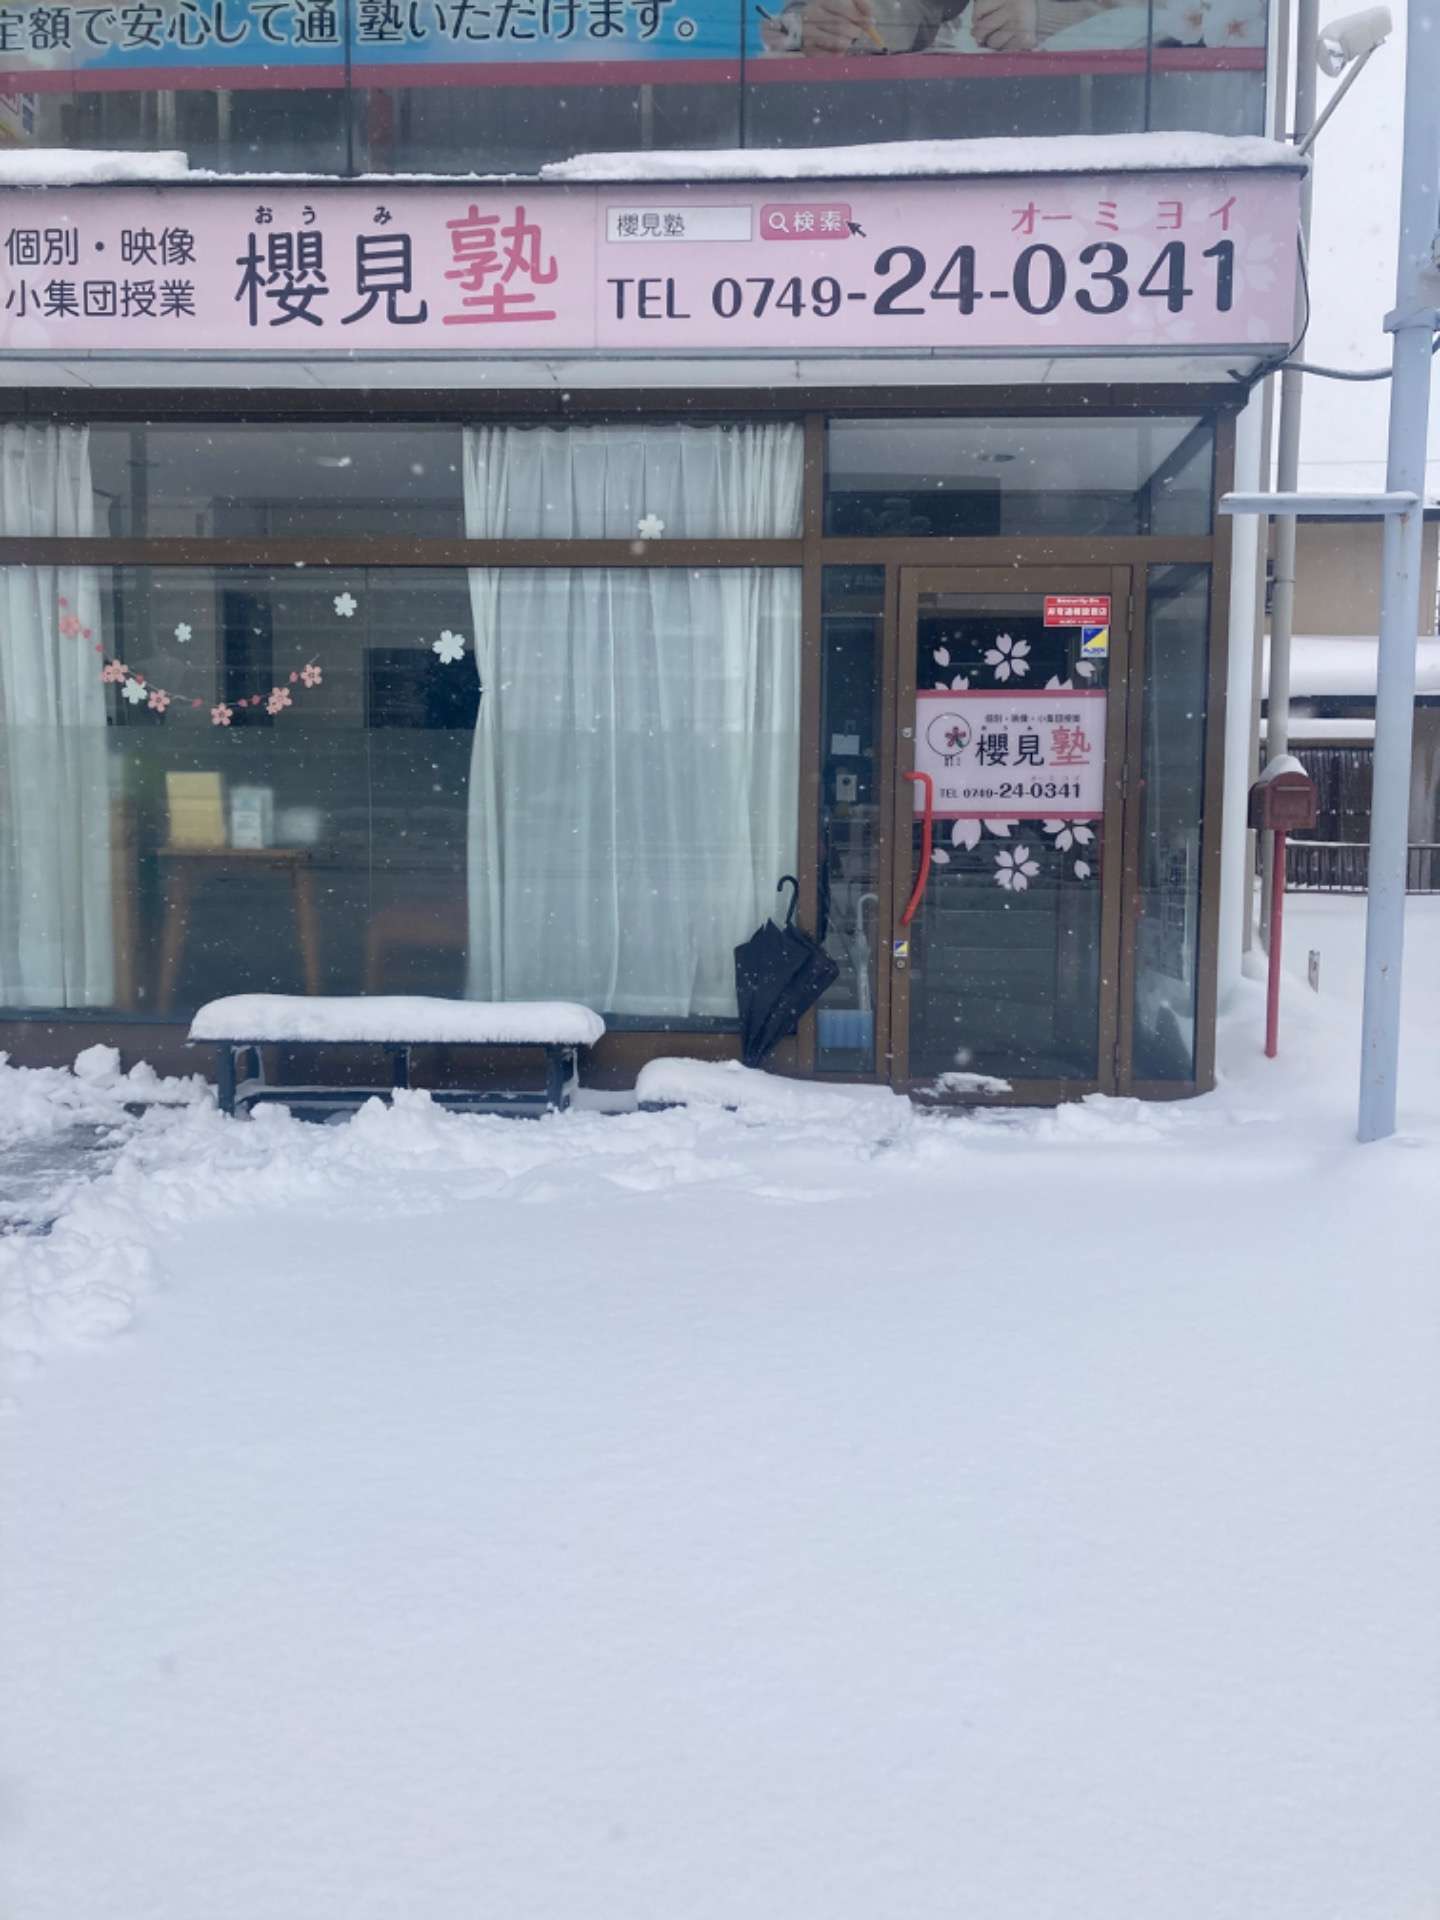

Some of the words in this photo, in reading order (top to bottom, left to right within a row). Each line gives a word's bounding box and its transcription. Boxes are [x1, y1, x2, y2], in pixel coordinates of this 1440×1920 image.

[255, 206, 393, 226] おうみ
[617, 212, 685, 237] 櫻見塾
[793, 210, 842, 232] 検索
[1010, 197, 1238, 235] オーミヨイ
[5, 227, 196, 266] 個別・映像
[234, 204, 559, 327] 櫻見塾
[5, 279, 196, 318] 小集団授業
[607, 278, 691, 320] TEL
[711, 239, 1235, 320] 0749-24-0341
[975, 725, 1091, 767] 櫻見塾
[940, 788, 958, 798] TEL
